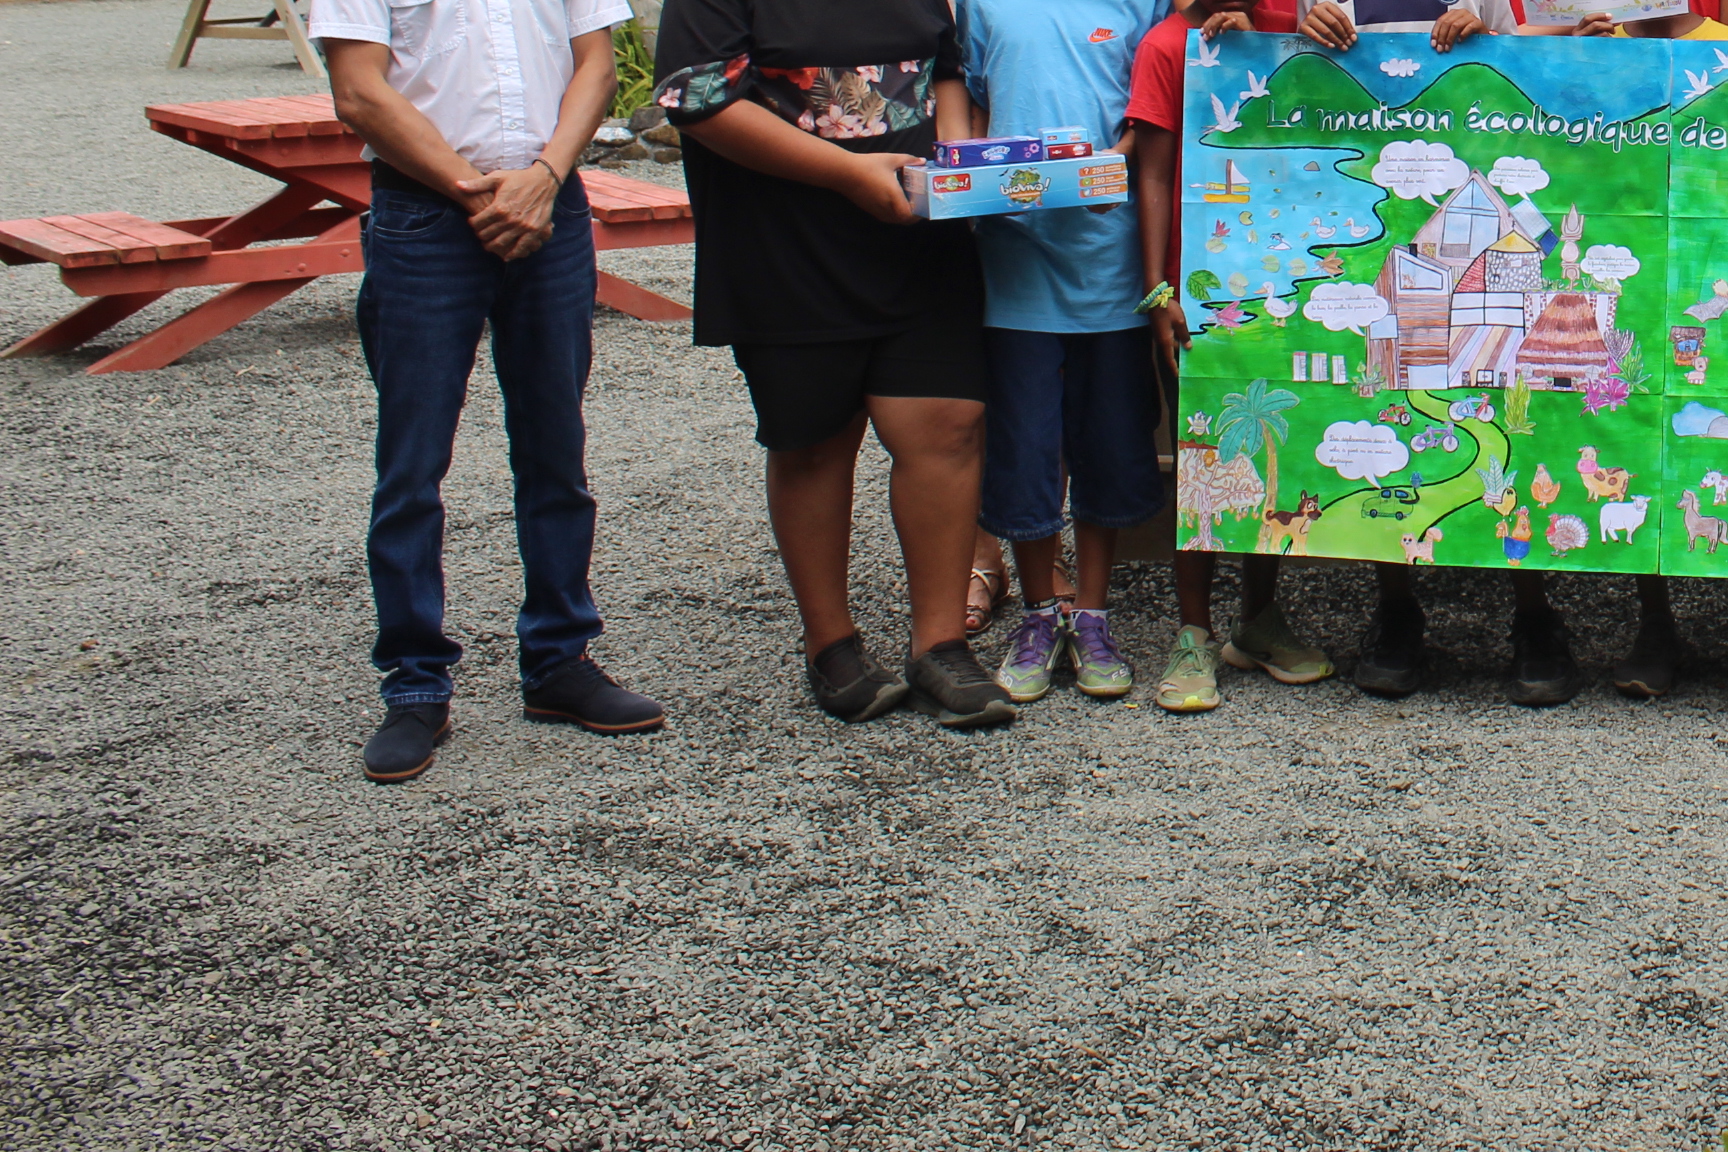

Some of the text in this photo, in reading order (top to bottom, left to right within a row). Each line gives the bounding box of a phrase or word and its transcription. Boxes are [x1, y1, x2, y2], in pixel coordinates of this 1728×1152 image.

[1267, 100, 1307, 128] La
[1316, 100, 1454, 132] maison
[1463, 100, 1670, 153] écologique
[1680, 117, 1727, 149] de
[1092, 166, 1105, 174] 250
[1093, 177, 1105, 185] 250
[1093, 188, 1106, 196] 250
